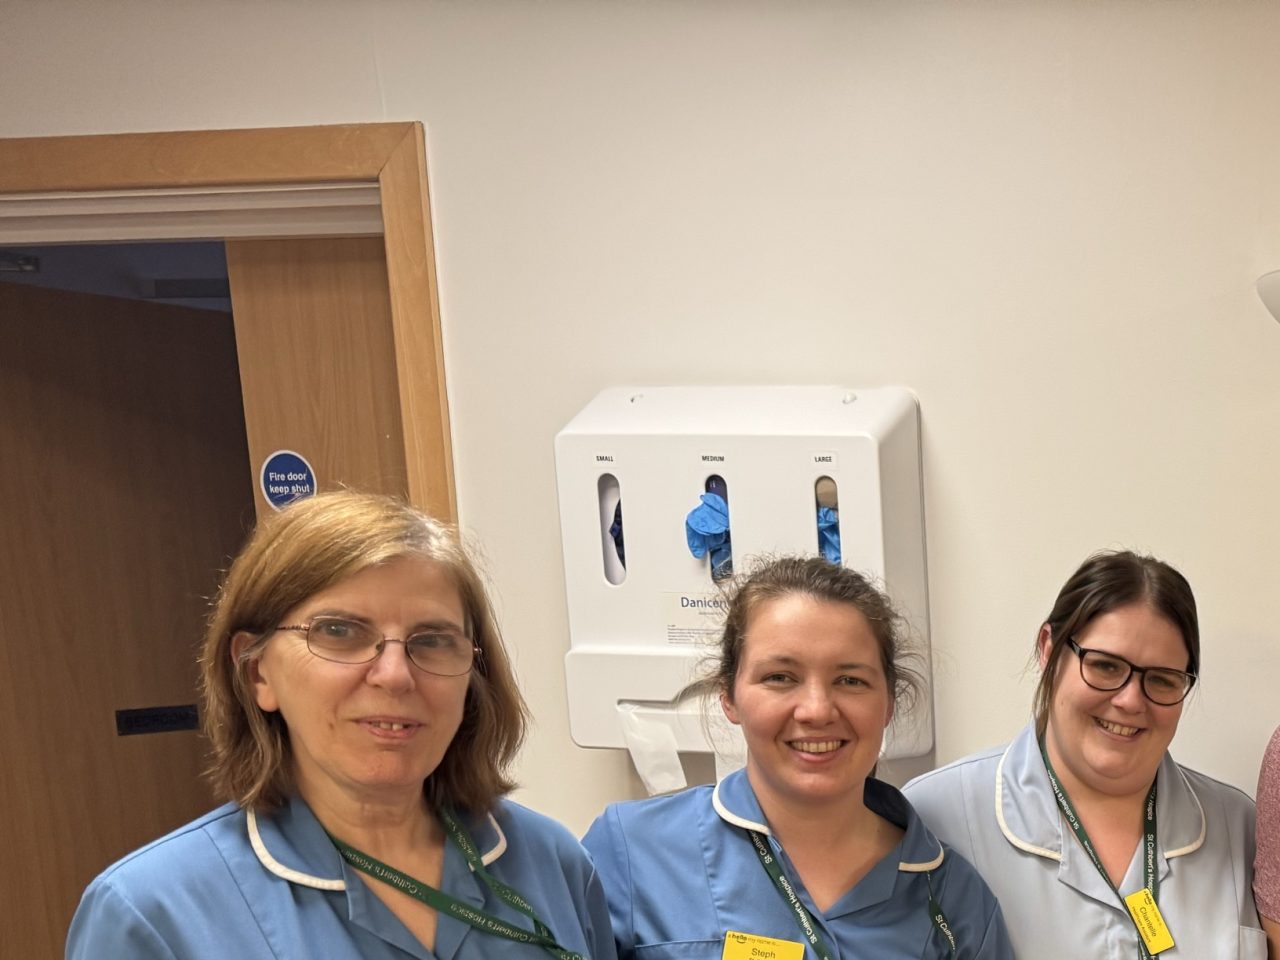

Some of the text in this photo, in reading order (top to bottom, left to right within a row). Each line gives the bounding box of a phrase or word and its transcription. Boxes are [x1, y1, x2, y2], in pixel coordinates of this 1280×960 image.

[269, 472, 307, 481] Fire door
[269, 484, 310, 494] keep shut
[751, 831, 773, 864] St Cuthbe
[779, 875, 818, 944] St Cuthbert's Hospice
[935, 914, 942, 924] St
[751, 947, 776, 959] Steph
